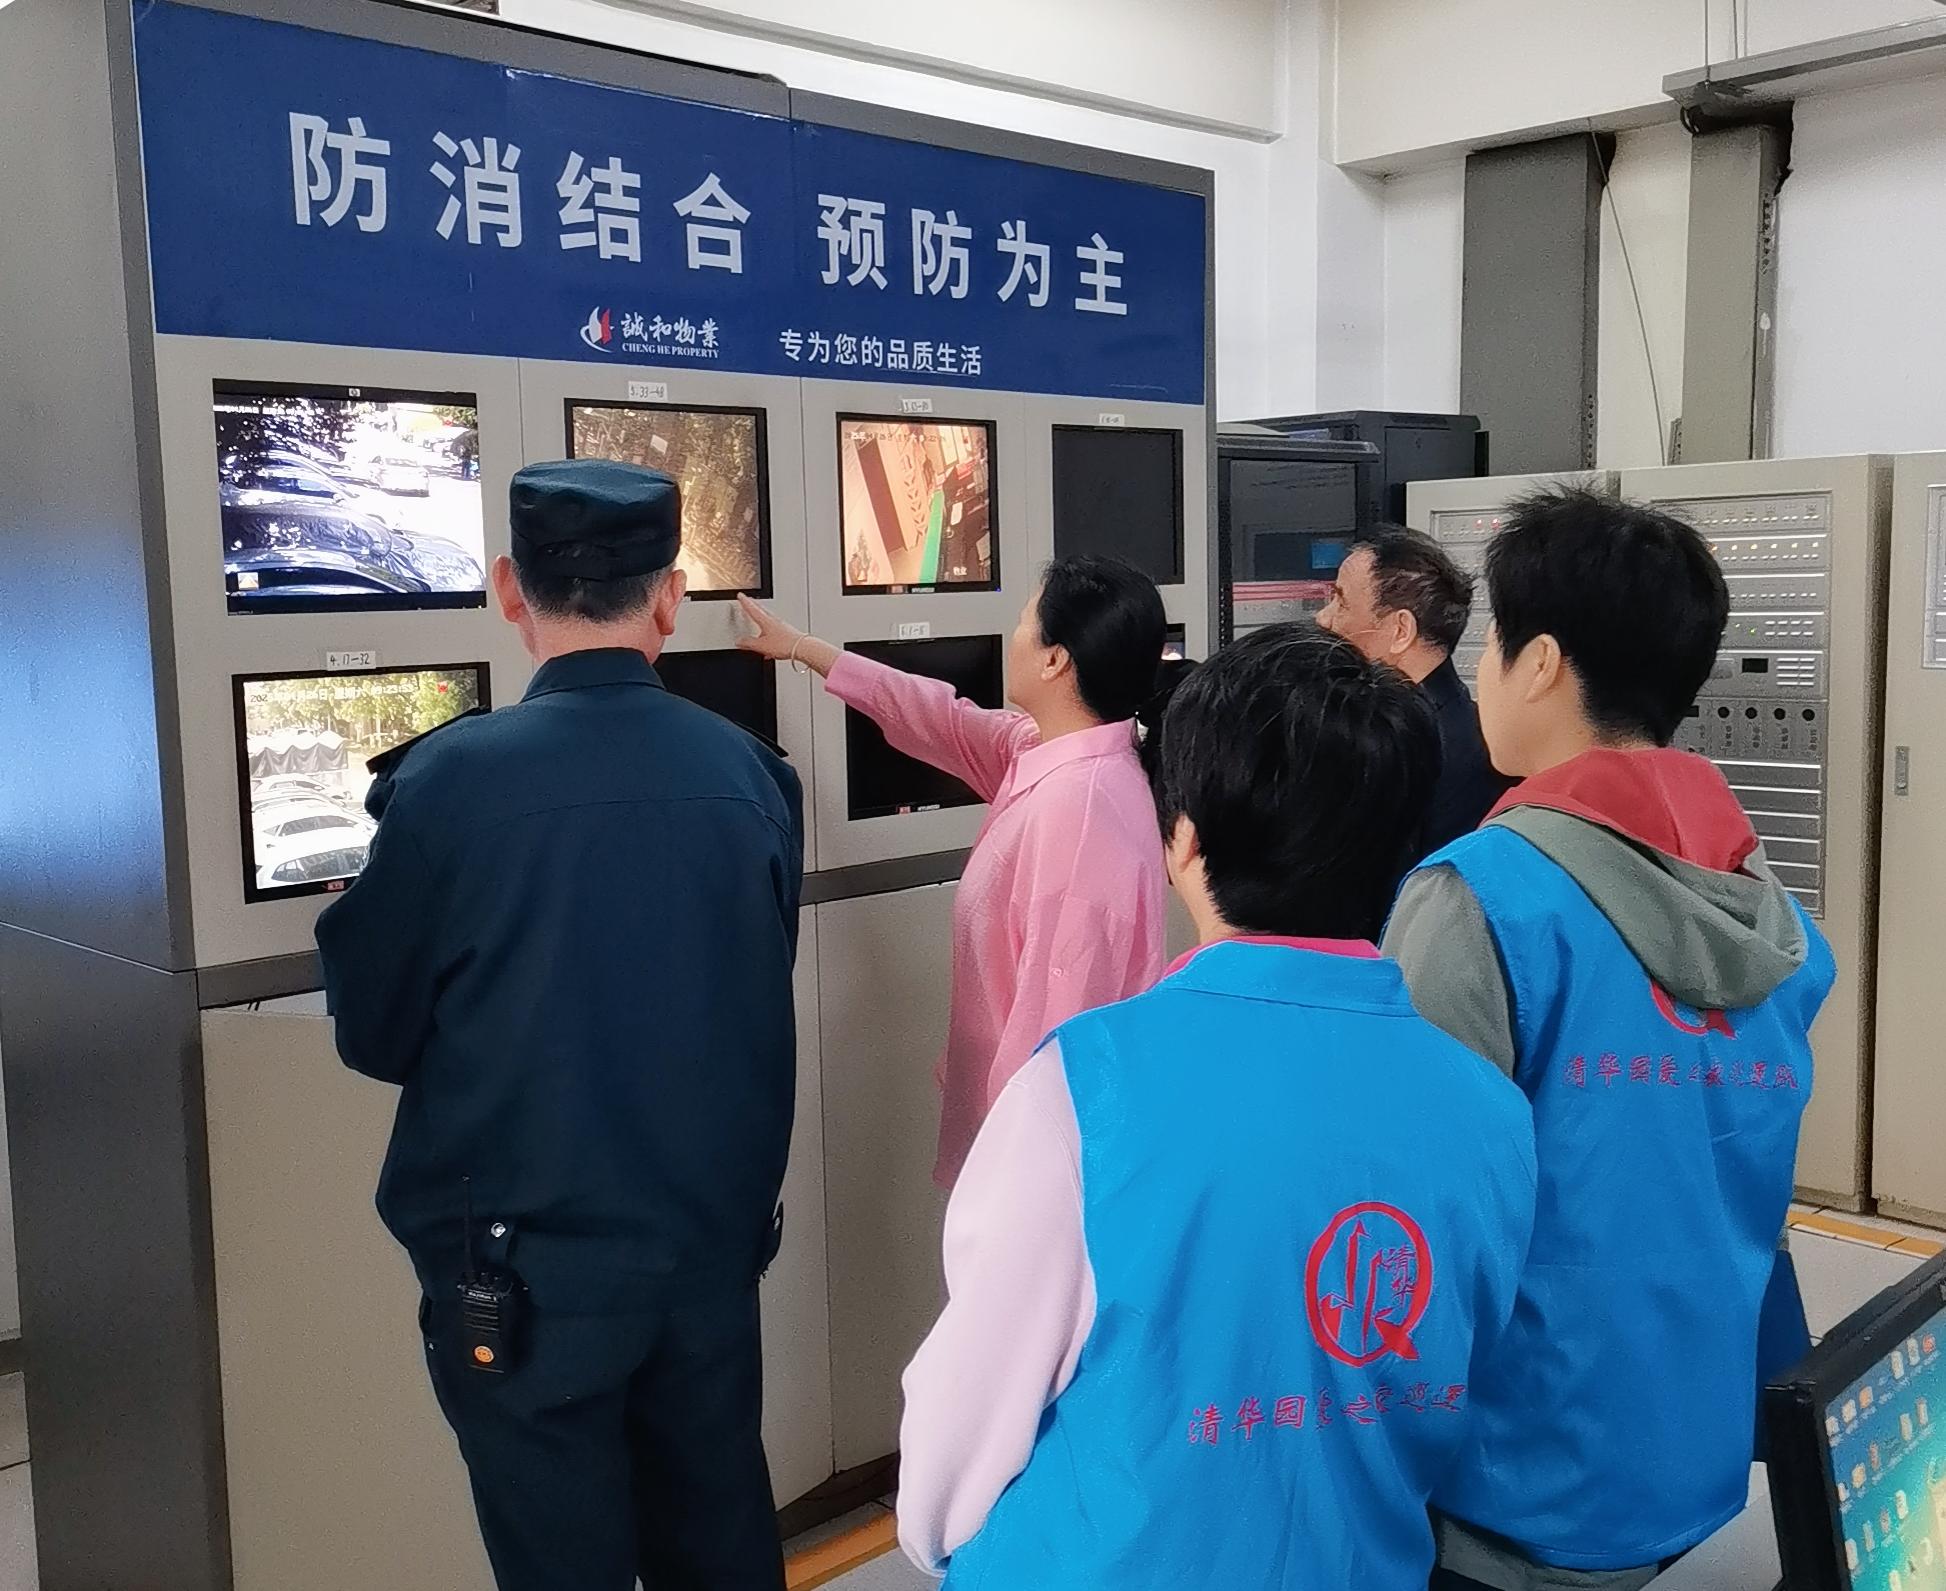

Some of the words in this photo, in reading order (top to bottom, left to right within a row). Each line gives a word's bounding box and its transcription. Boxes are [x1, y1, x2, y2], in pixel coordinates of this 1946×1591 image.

[289, 112, 751, 274] 防消结合
[817, 194, 1127, 315] 预防为主
[620, 312, 719, 348] 誠和物業
[621, 342, 656, 354] CHENG
[657, 345, 671, 355] HE
[672, 346, 719, 358] PROPERTY
[779, 329, 982, 375] 专为您的品质生活
